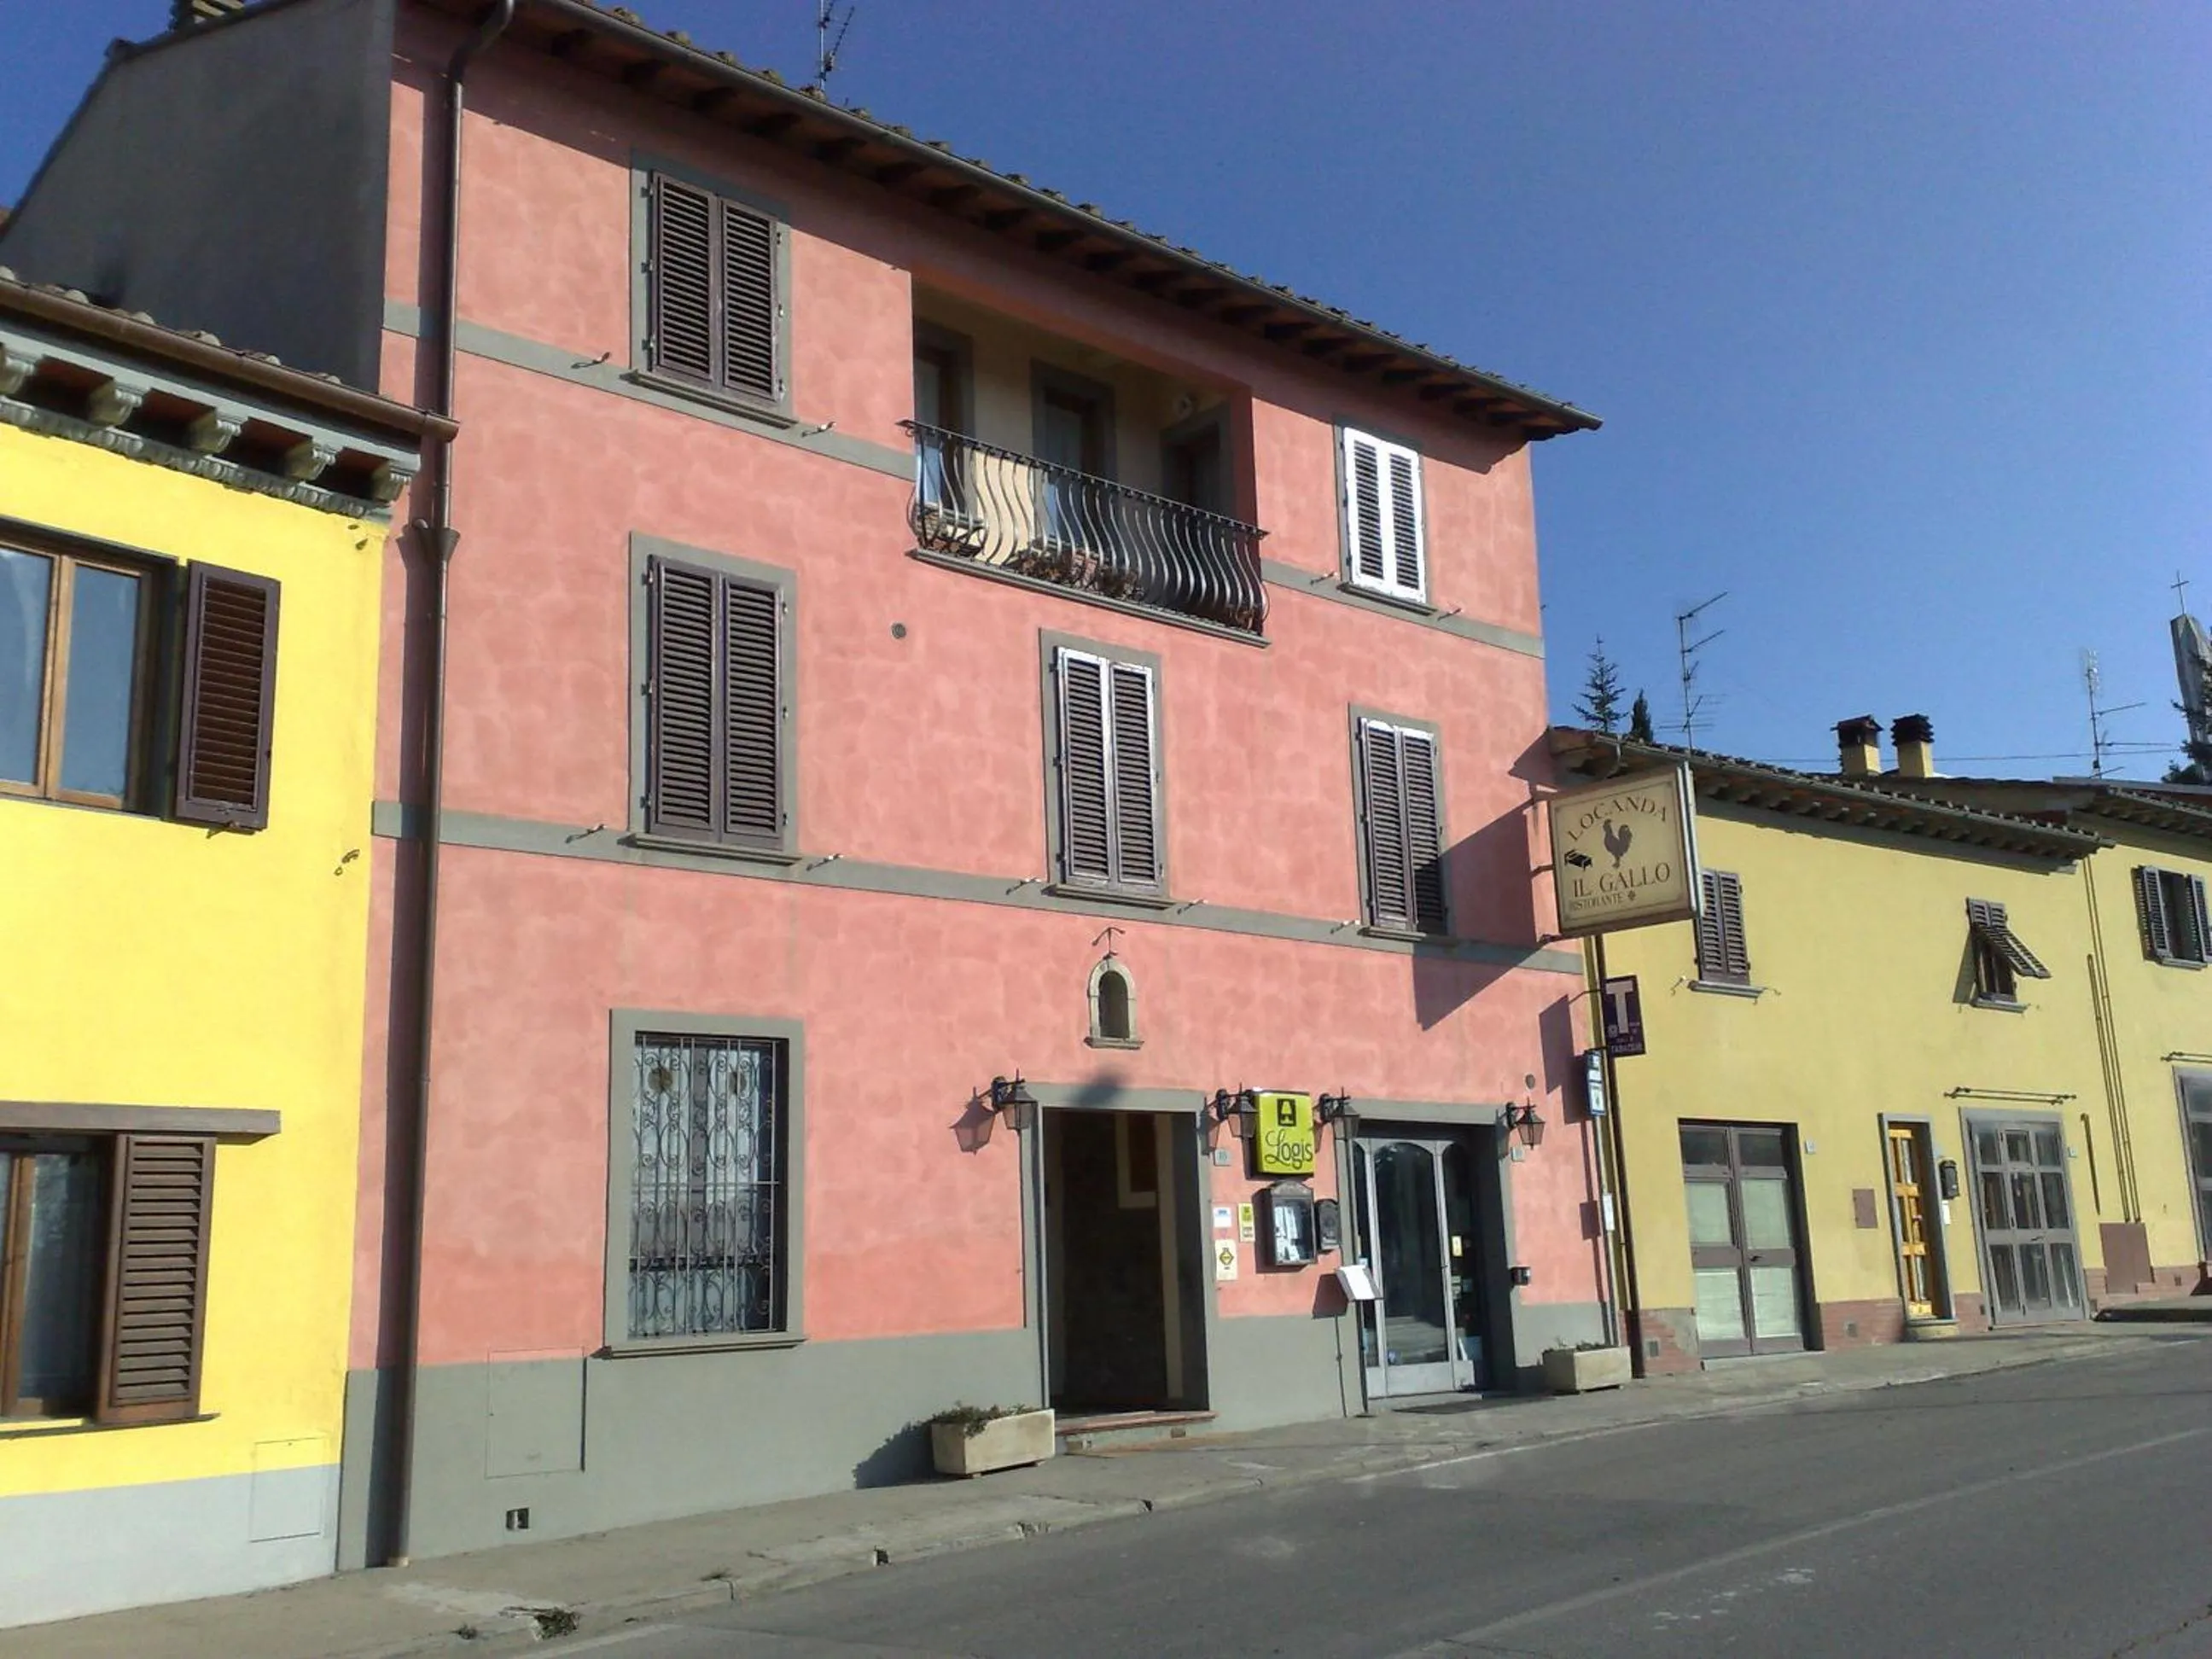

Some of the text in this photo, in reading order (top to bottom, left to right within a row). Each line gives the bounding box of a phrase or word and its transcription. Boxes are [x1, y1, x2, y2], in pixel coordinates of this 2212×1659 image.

[1567, 795, 1667, 841] LOCANDA
[1574, 862, 1671, 898] IL GALLO
[1605, 981, 1633, 1034] T
[1265, 1130, 1314, 1170] Logis
